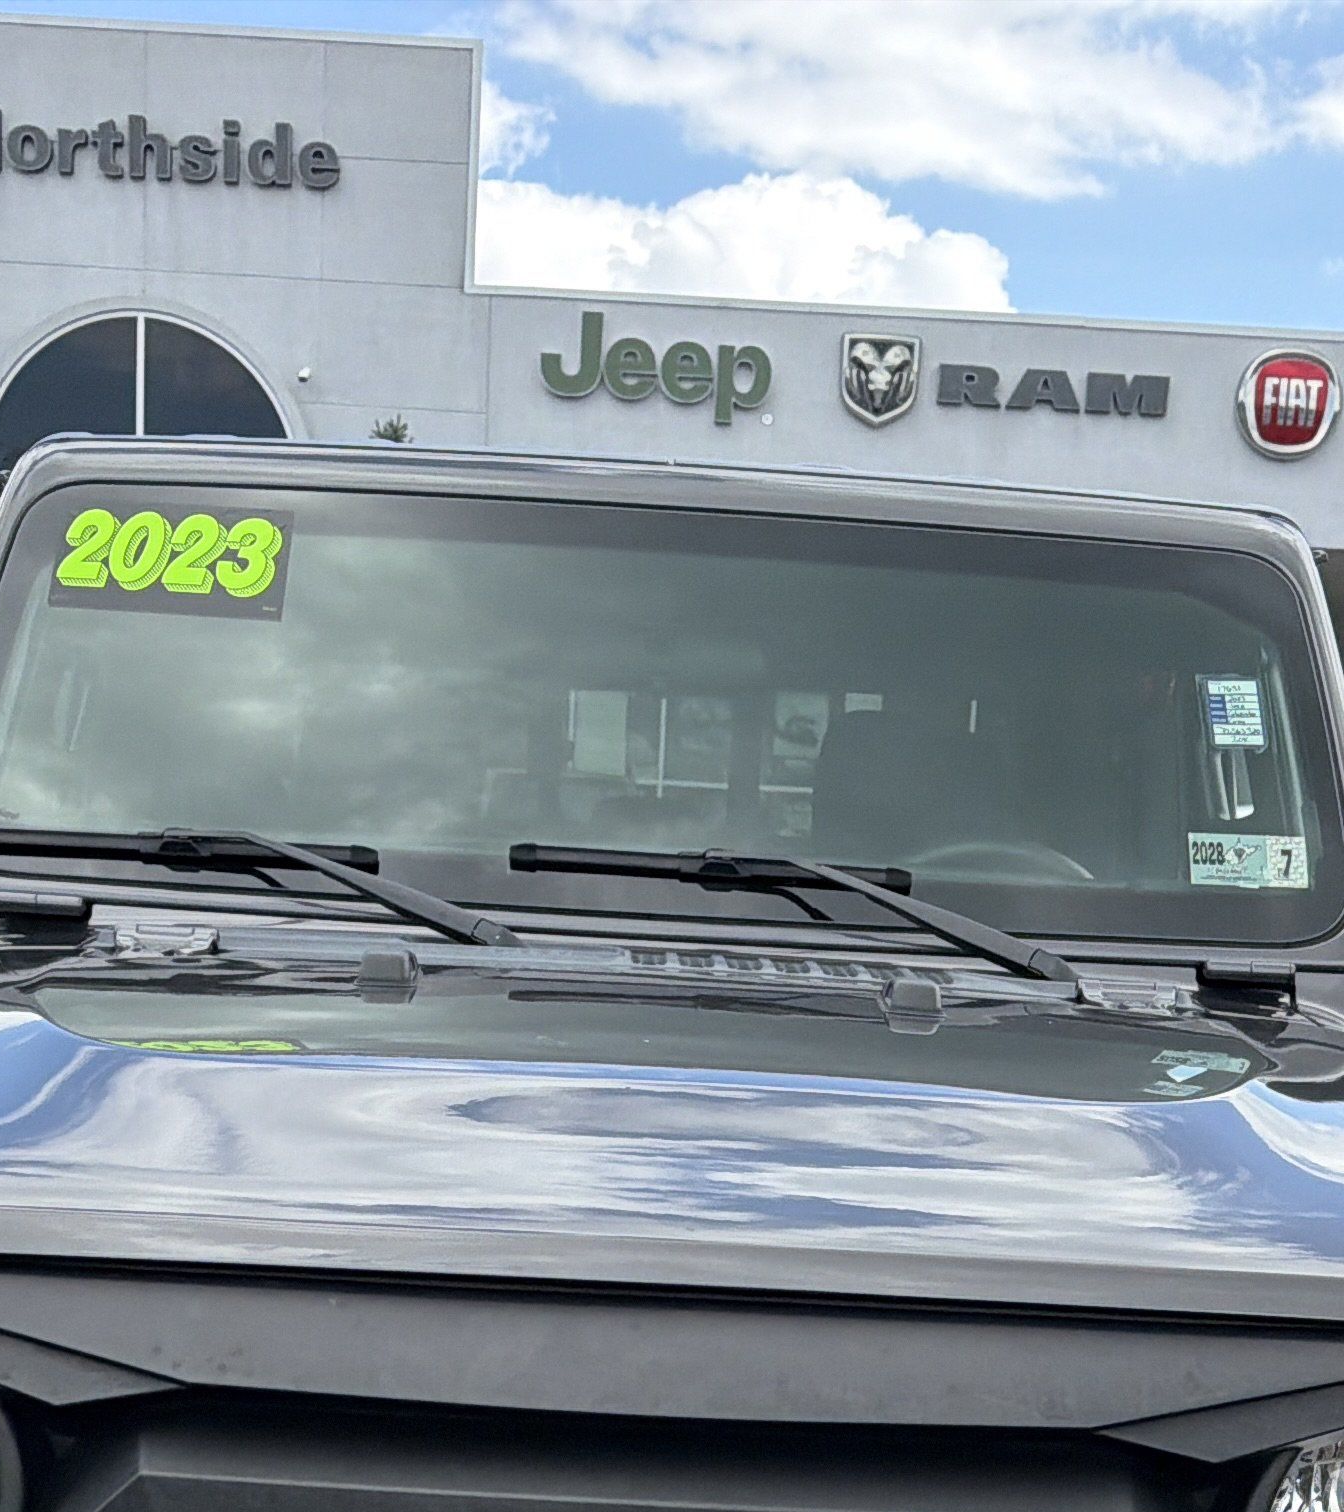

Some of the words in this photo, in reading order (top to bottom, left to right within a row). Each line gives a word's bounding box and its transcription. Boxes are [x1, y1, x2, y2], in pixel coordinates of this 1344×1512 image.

[540, 311, 773, 425] Jeep
[936, 362, 1171, 417] RAM
[1262, 377, 1324, 427] FIAT
[56, 508, 283, 598] 2023
[1191, 840, 1226, 866] 2028
